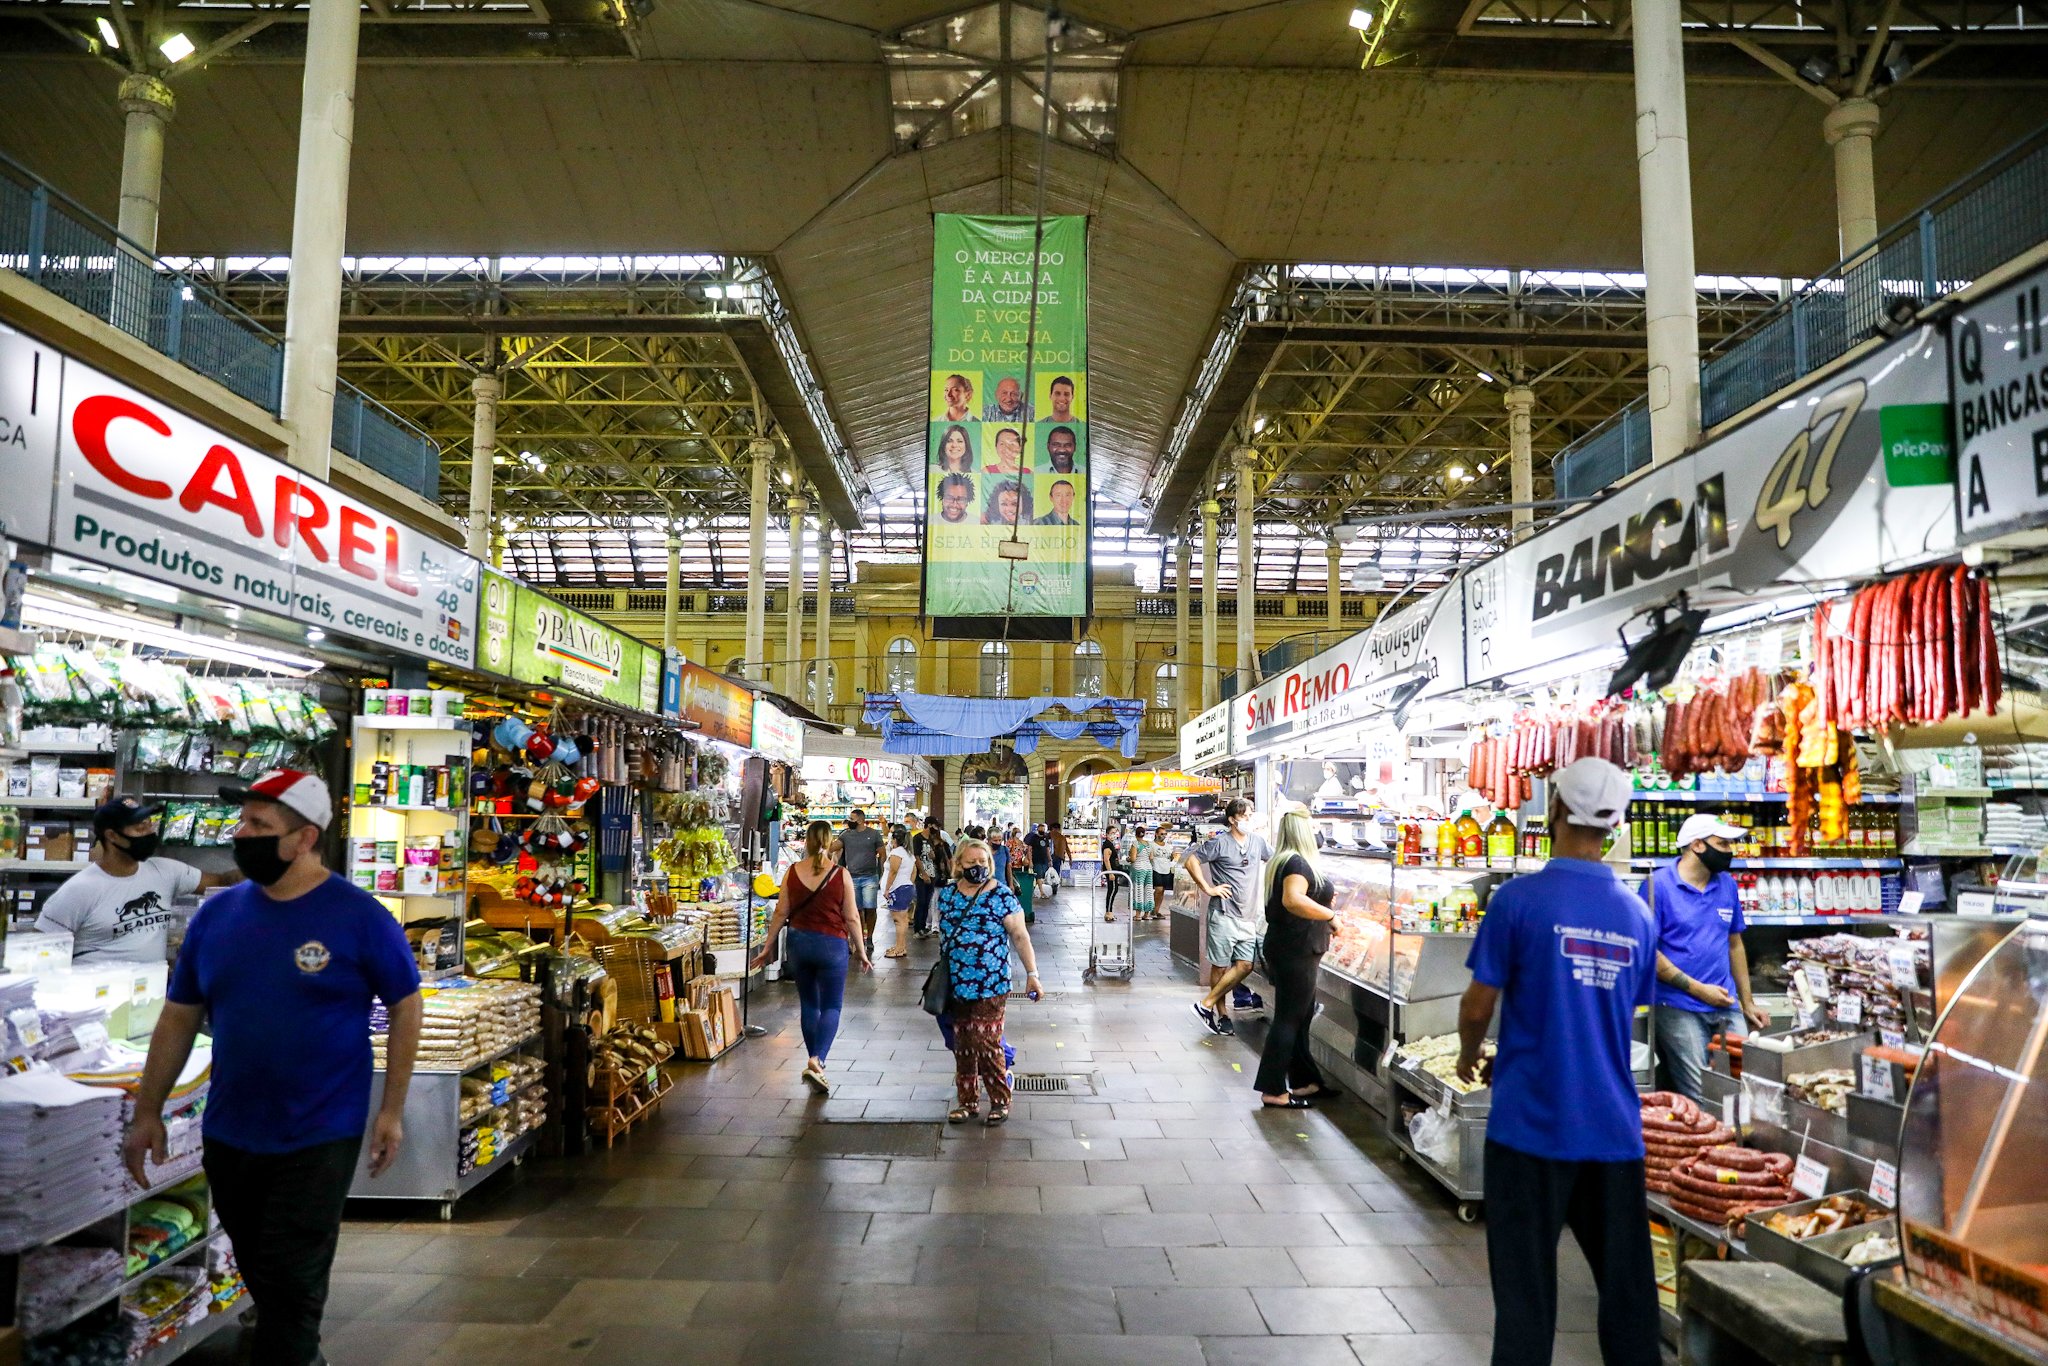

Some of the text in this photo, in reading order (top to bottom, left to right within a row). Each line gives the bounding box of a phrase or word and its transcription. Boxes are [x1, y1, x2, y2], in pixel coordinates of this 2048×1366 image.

[956, 250, 1064, 265] O MERCADO
[964, 266, 1054, 285] É A ALMA
[962, 290, 1062, 305] DA CIDADE.
[975, 307, 1042, 324] E VOCÊ
[963, 325, 974, 343] É
[980, 330, 993, 343] A
[949, 349, 974, 362] DO
[1958, 318, 1983, 386] Q
[1892, 439, 1949, 458] PicPay
[73, 394, 419, 597] CAREL
[1967, 453, 1990, 518] A
[1532, 376, 1868, 622] BANCA 47
[934, 536, 974, 549] SEJA
[420, 551, 473, 594] bca
[73, 513, 224, 585] Produtos
[234, 572, 336, 623] naturais,
[343, 606, 409, 643] cereais
[414, 632, 425, 647] e
[429, 634, 469, 662] doces
[489, 583, 499, 608] Q
[1472, 577, 1484, 611] Q
[436, 589, 459, 613] 48
[488, 619, 506, 634] BANCA
[1472, 609, 1498, 635] BANCA
[489, 637, 499, 662] C
[551, 614, 612, 663] BANCA
[1370, 615, 1430, 666] Açougue
[1481, 636, 1492, 671] R
[564, 664, 586, 682] Rancho
[1246, 693, 1277, 731] SAN
[1283, 662, 1350, 718] REMO
[1293, 703, 1350, 731] banca 18 e 19
[853, 761, 869, 780] 10
[1163, 777, 1190, 788] Banca
[113, 913, 171, 934] LEADER
